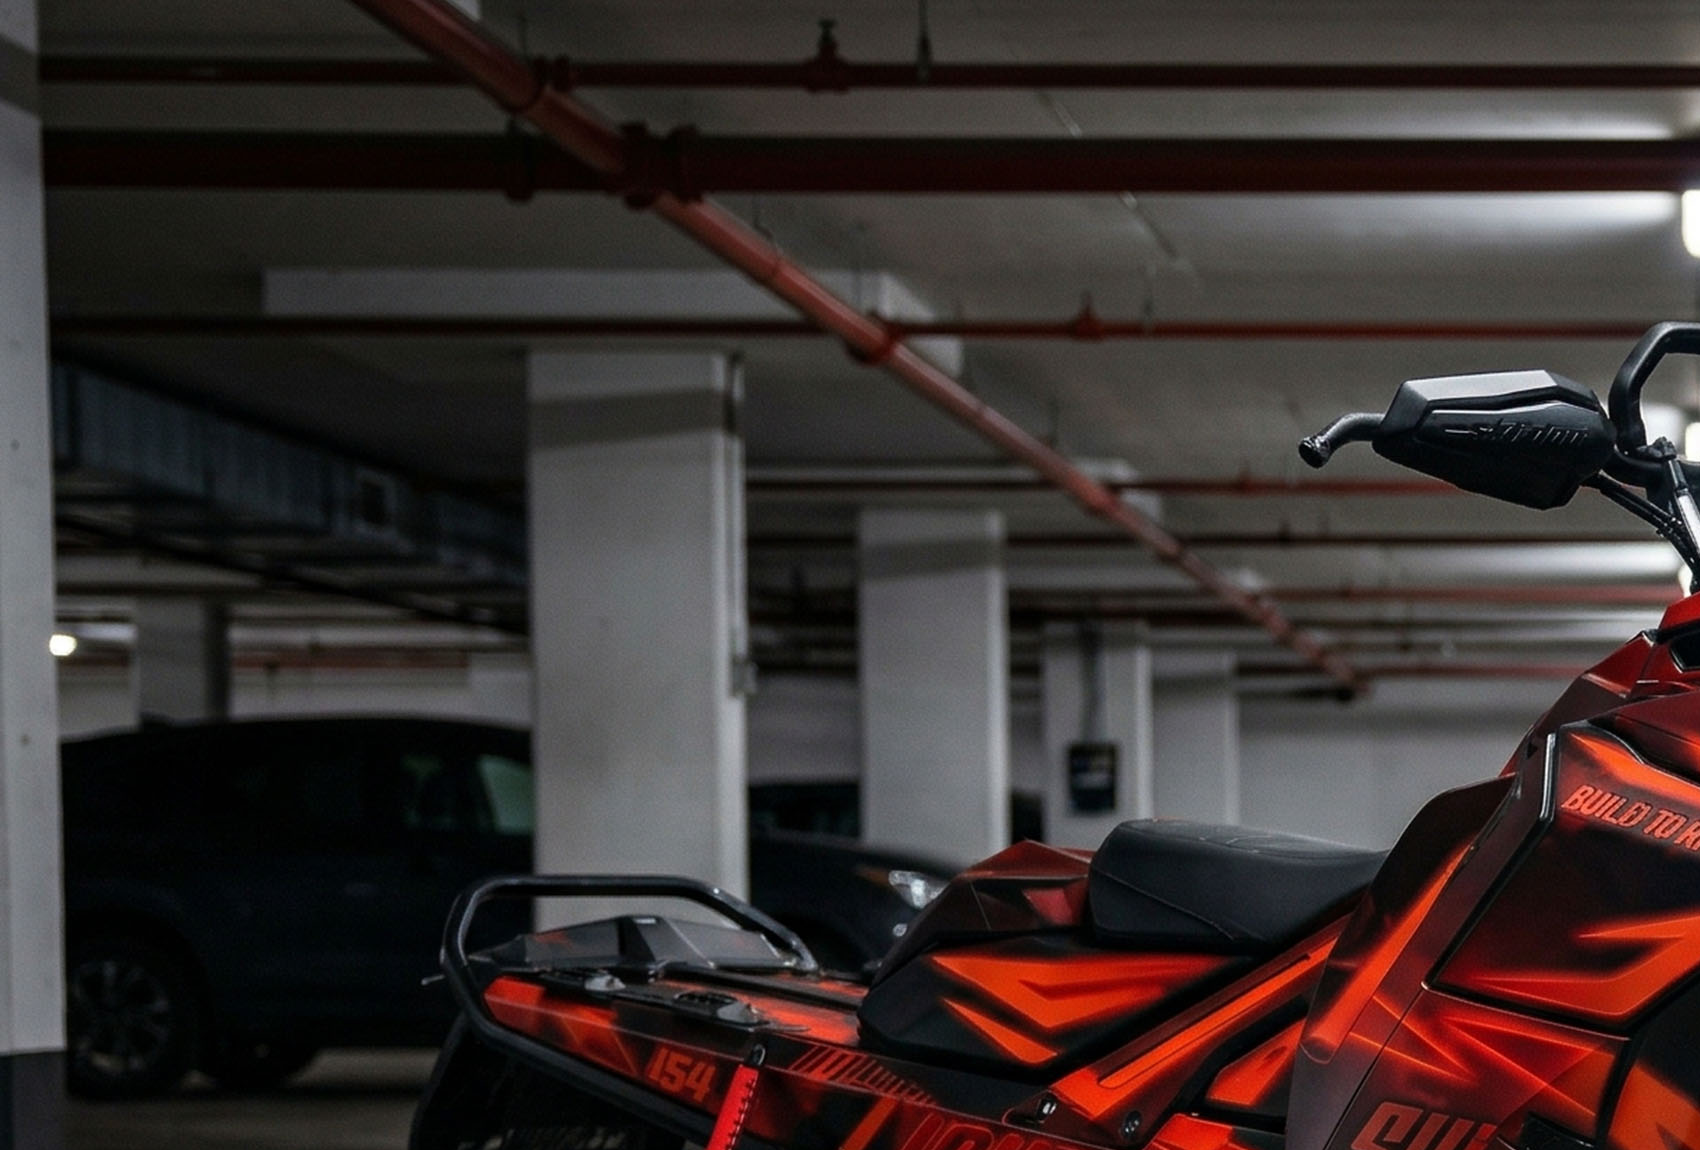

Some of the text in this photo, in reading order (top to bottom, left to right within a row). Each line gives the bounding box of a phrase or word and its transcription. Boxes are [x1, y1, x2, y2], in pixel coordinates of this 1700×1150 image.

[1561, 784, 1650, 829] BUILD
[1643, 807, 1681, 841] TO
[647, 1046, 717, 1104] 154
